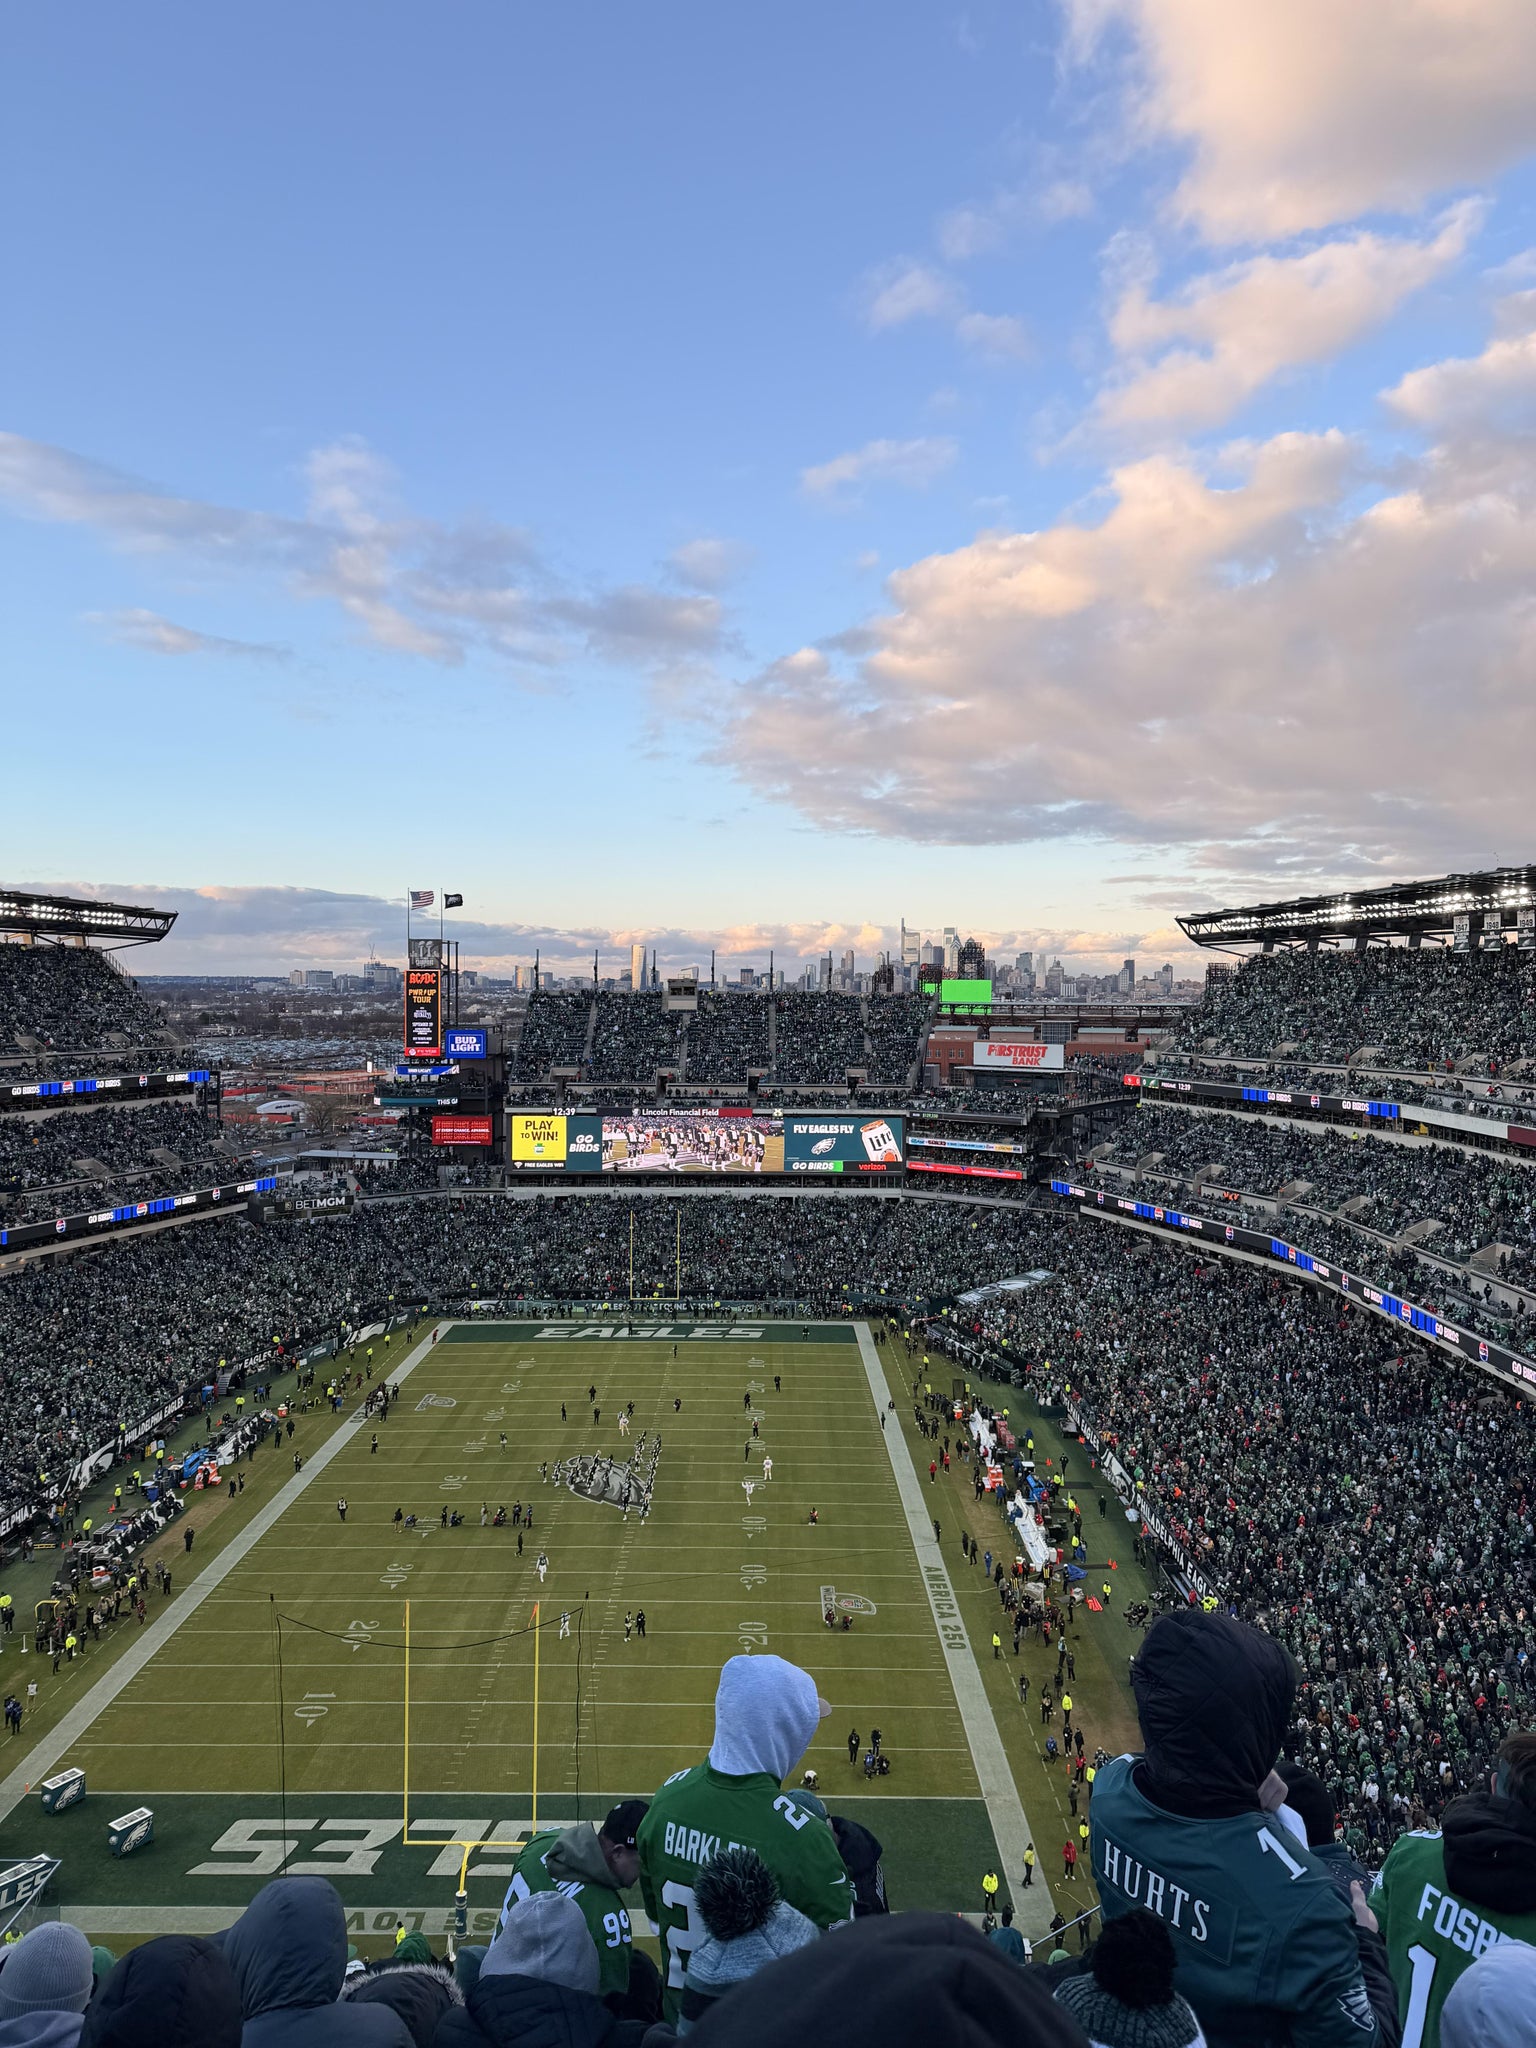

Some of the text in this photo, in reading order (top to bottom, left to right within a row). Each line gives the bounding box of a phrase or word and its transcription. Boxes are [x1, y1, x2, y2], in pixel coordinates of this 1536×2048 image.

[409, 973, 436, 984] AC/DC
[412, 996, 431, 1004] TOUR
[455, 1036, 477, 1044] BUD
[450, 1044, 481, 1052] LIGHT
[987, 1044, 1048, 1057] FIRSTRUST
[1012, 1057, 1041, 1066] BANK
[95, 1080, 104, 1088] GO
[167, 1074, 174, 1082] GO
[11, 1087, 22, 1096] GO
[1267, 1092, 1275, 1100] GO
[1341, 1100, 1351, 1109] GO
[553, 1108, 576, 1116] 12:39
[642, 1108, 667, 1116] Lincoln
[669, 1108, 700, 1116] Financial
[525, 1120, 554, 1131] PLAY
[793, 1124, 854, 1134] FLY EAGLES FLY
[531, 1131, 559, 1141] WIN!
[576, 1135, 594, 1144] GO
[569, 1143, 600, 1153] BIRDS
[792, 1162, 834, 1170] GO BIRDS
[858, 1163, 887, 1171] verizon
[295, 1197, 345, 1210] BETMGM
[88, 1214, 97, 1224] GO
[533, 1327, 766, 1339] EAGLES
[1435, 1322, 1443, 1335] GO
[1512, 1361, 1522, 1376] GO
[124, 1395, 184, 1447] PHILADELPHIA EAGLES
[742, 1516, 767, 1534] 40
[1136, 1493, 1185, 1570] PHILADELPHIA
[379, 1563, 414, 1584] 30
[740, 1564, 768, 1584] 30
[923, 1565, 967, 1650] AMERICA 250
[341, 1620, 379, 1645] 20
[738, 1621, 768, 1646] 20
[294, 1691, 336, 1718] 10
[773, 1795, 810, 1831] 2
[664, 1822, 757, 1865] BARKL
[1256, 1826, 1308, 1881] 1
[1103, 1838, 1210, 1942] HURTS
[346, 1911, 427, 1931] LOV
[602, 1909, 632, 1948] 99
[1401, 1944, 1437, 2048] 1
